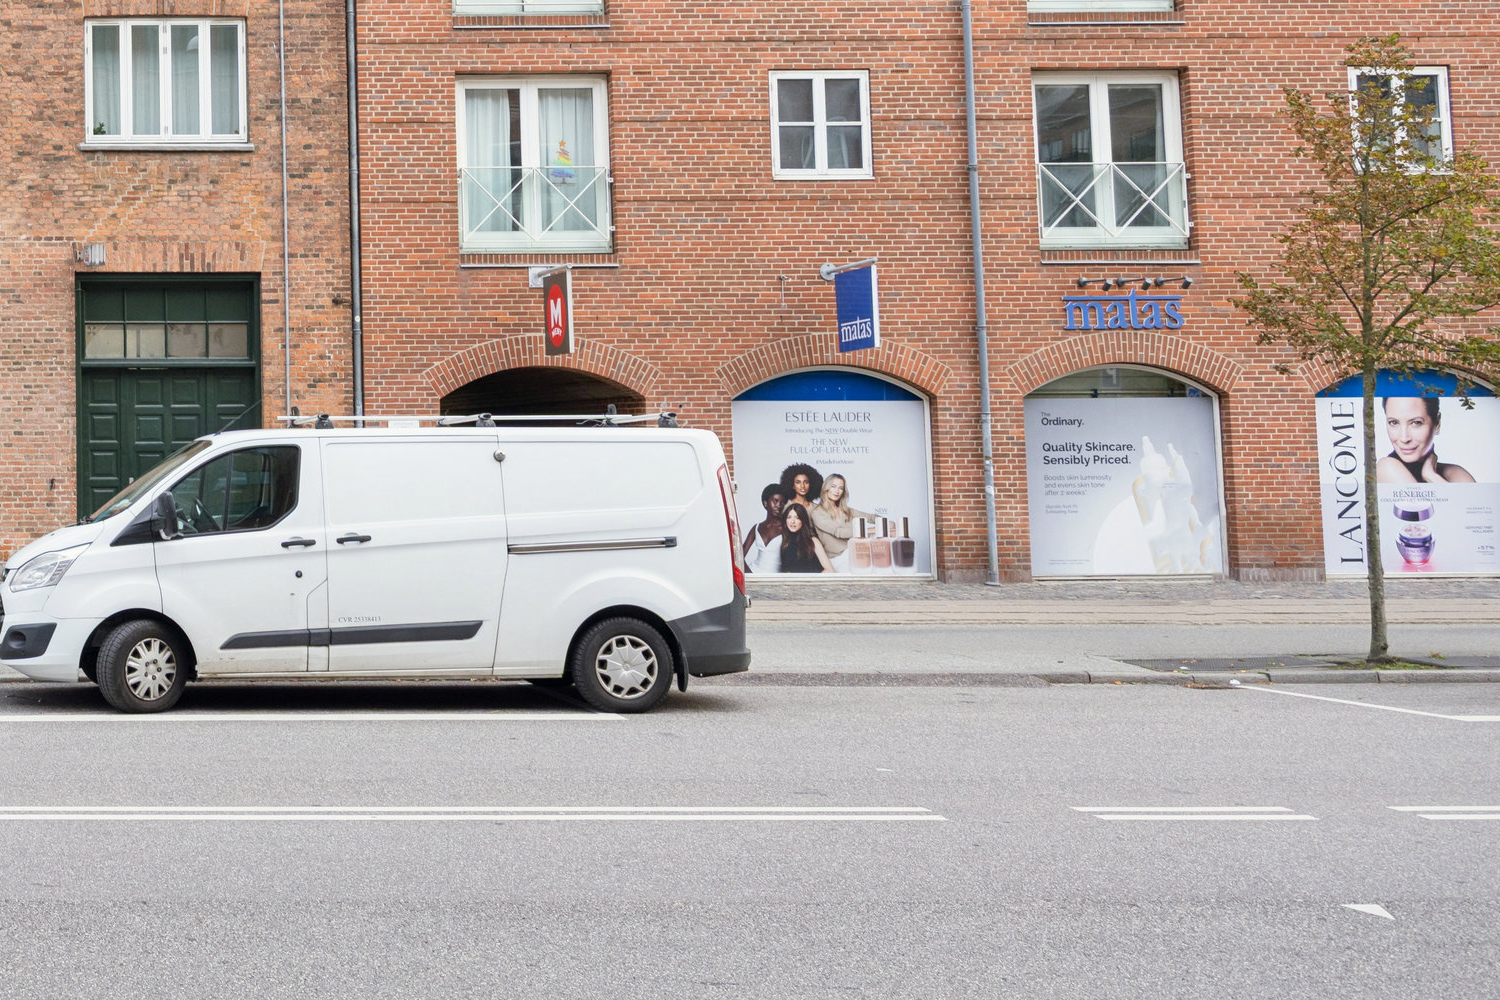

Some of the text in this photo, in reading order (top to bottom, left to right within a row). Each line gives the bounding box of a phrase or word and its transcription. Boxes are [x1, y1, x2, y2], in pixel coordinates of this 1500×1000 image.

[550, 298, 563, 328] M
[1061, 288, 1184, 331] matas
[841, 316, 872, 342] matas
[823, 411, 872, 422] LAUDER
[1041, 417, 1085, 428] Ordinary.
[811, 438, 848, 446] THE NEW
[790, 446, 869, 454] FULL-OF-LIFE MATTE
[1042, 442, 1135, 454] Quality Skincare.
[1043, 455, 1131, 467] Sensibly Priced.
[1080, 474, 1112, 482] luminosity
[1329, 402, 1364, 563] LANCÔME
[1392, 489, 1436, 498] RÉNERGIE
